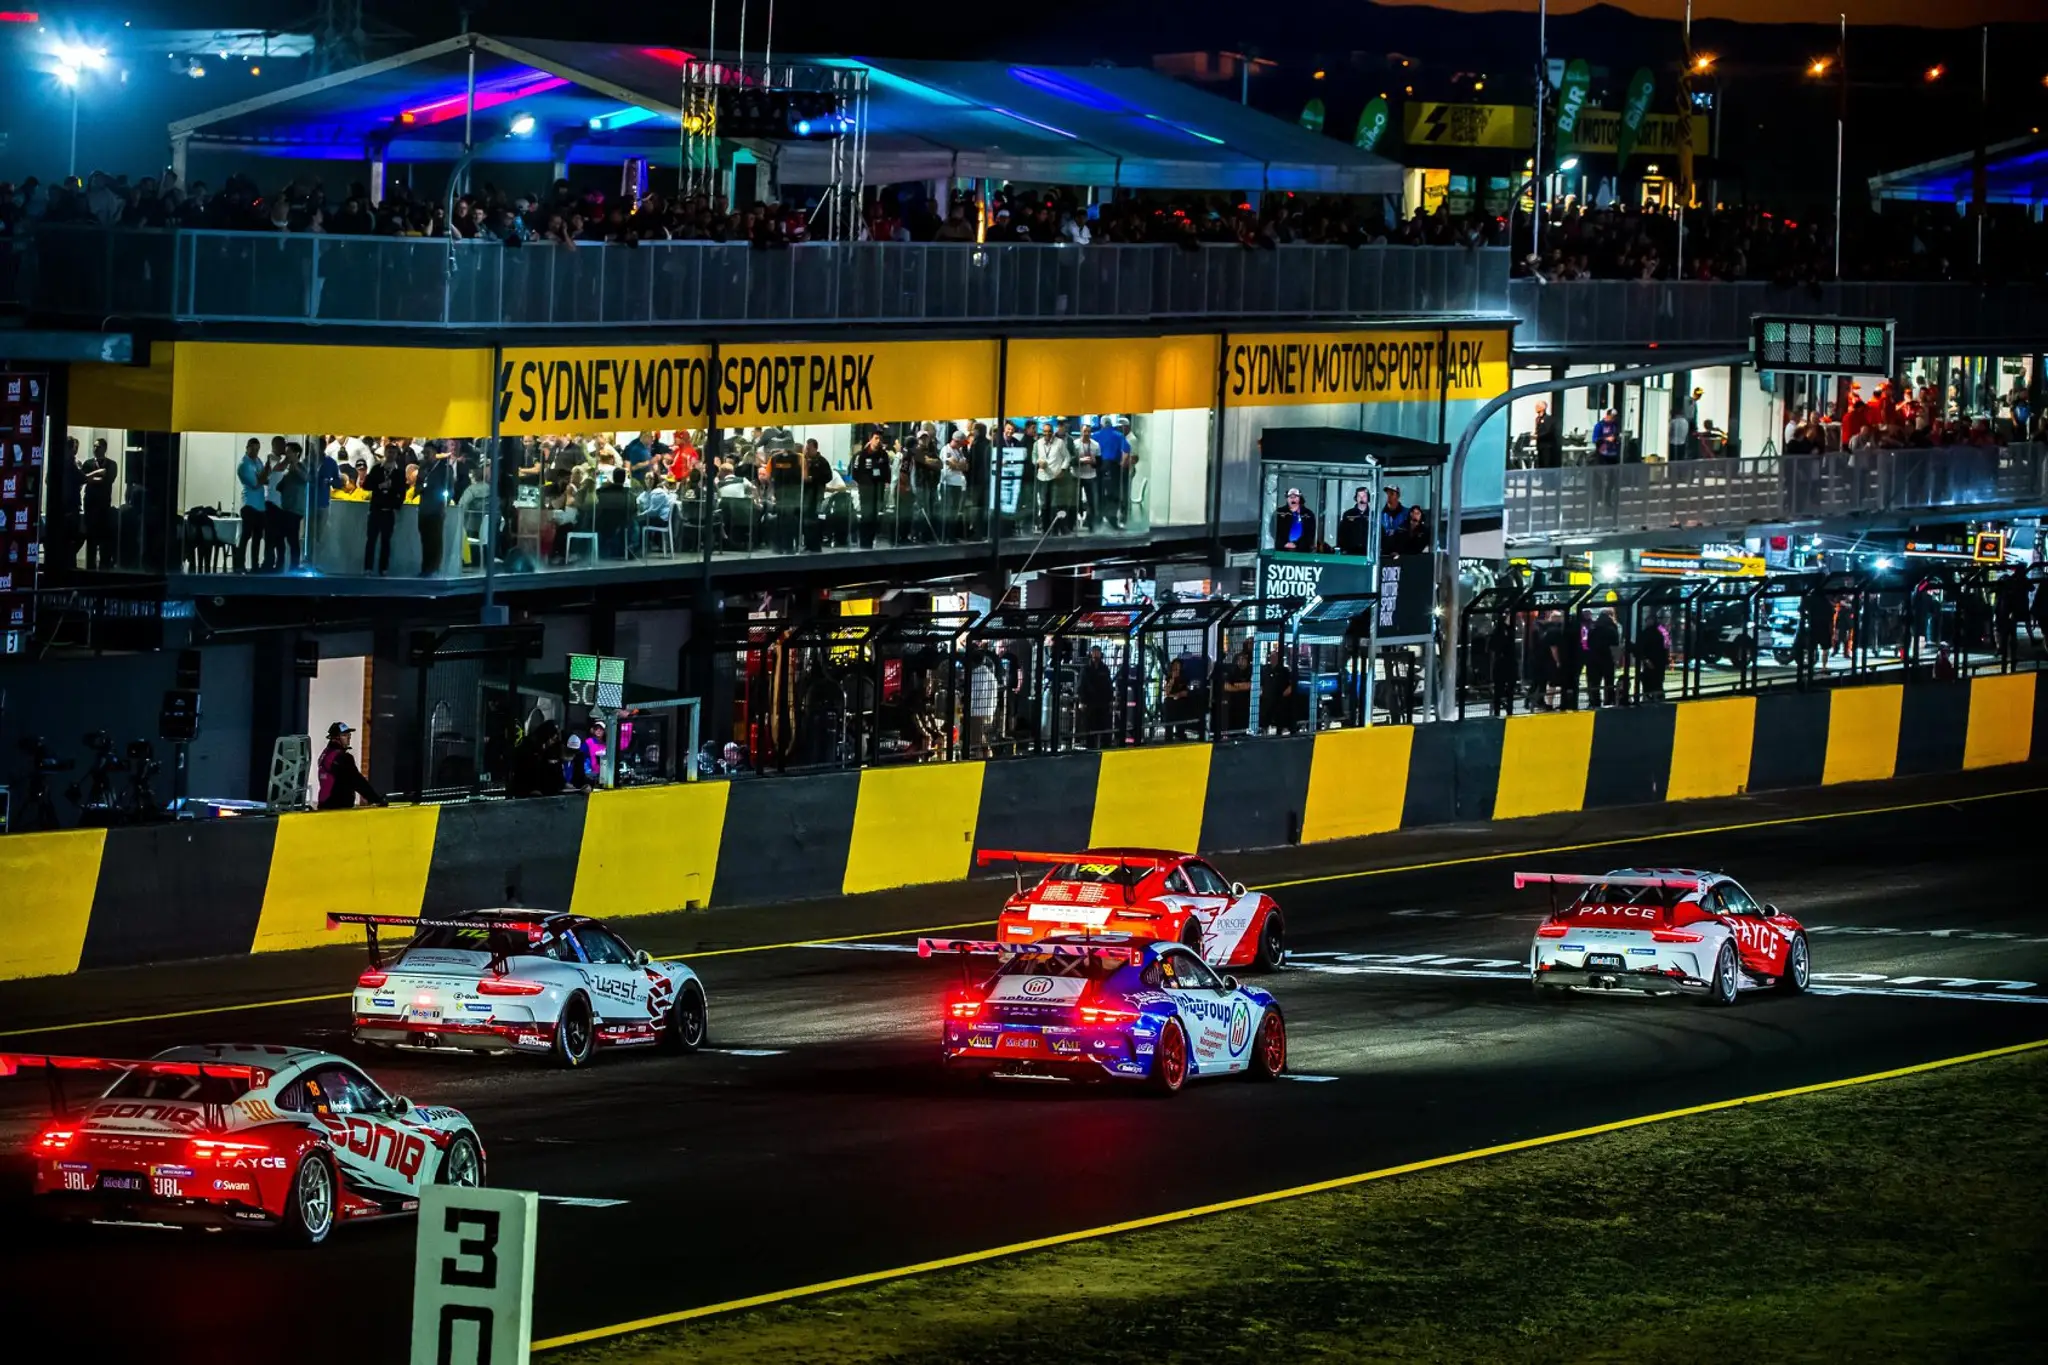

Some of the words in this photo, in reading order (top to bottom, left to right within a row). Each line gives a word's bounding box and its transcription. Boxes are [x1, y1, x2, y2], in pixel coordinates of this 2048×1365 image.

[1558, 85, 1586, 132] BAR
[1232, 344, 1311, 396] SYDNEY
[1312, 341, 1434, 392] MOTORSPORT
[519, 358, 629, 423] SYDNEY
[809, 354, 874, 413] PARK
[1268, 564, 1323, 583] SYDNEY
[1266, 580, 1317, 597] MOTOR
[1578, 905, 1657, 920] PAYCE
[1217, 918, 1246, 930] PORSCHE
[1723, 915, 1779, 960] PAYCE
[412, 1008, 432, 1019] Mobil
[90, 1103, 200, 1126] SONIQ
[314, 1112, 426, 1185] SONIQ
[64, 1171, 92, 1191] JBL
[154, 1177, 183, 1197] JBL
[223, 1180, 250, 1191] Swann
